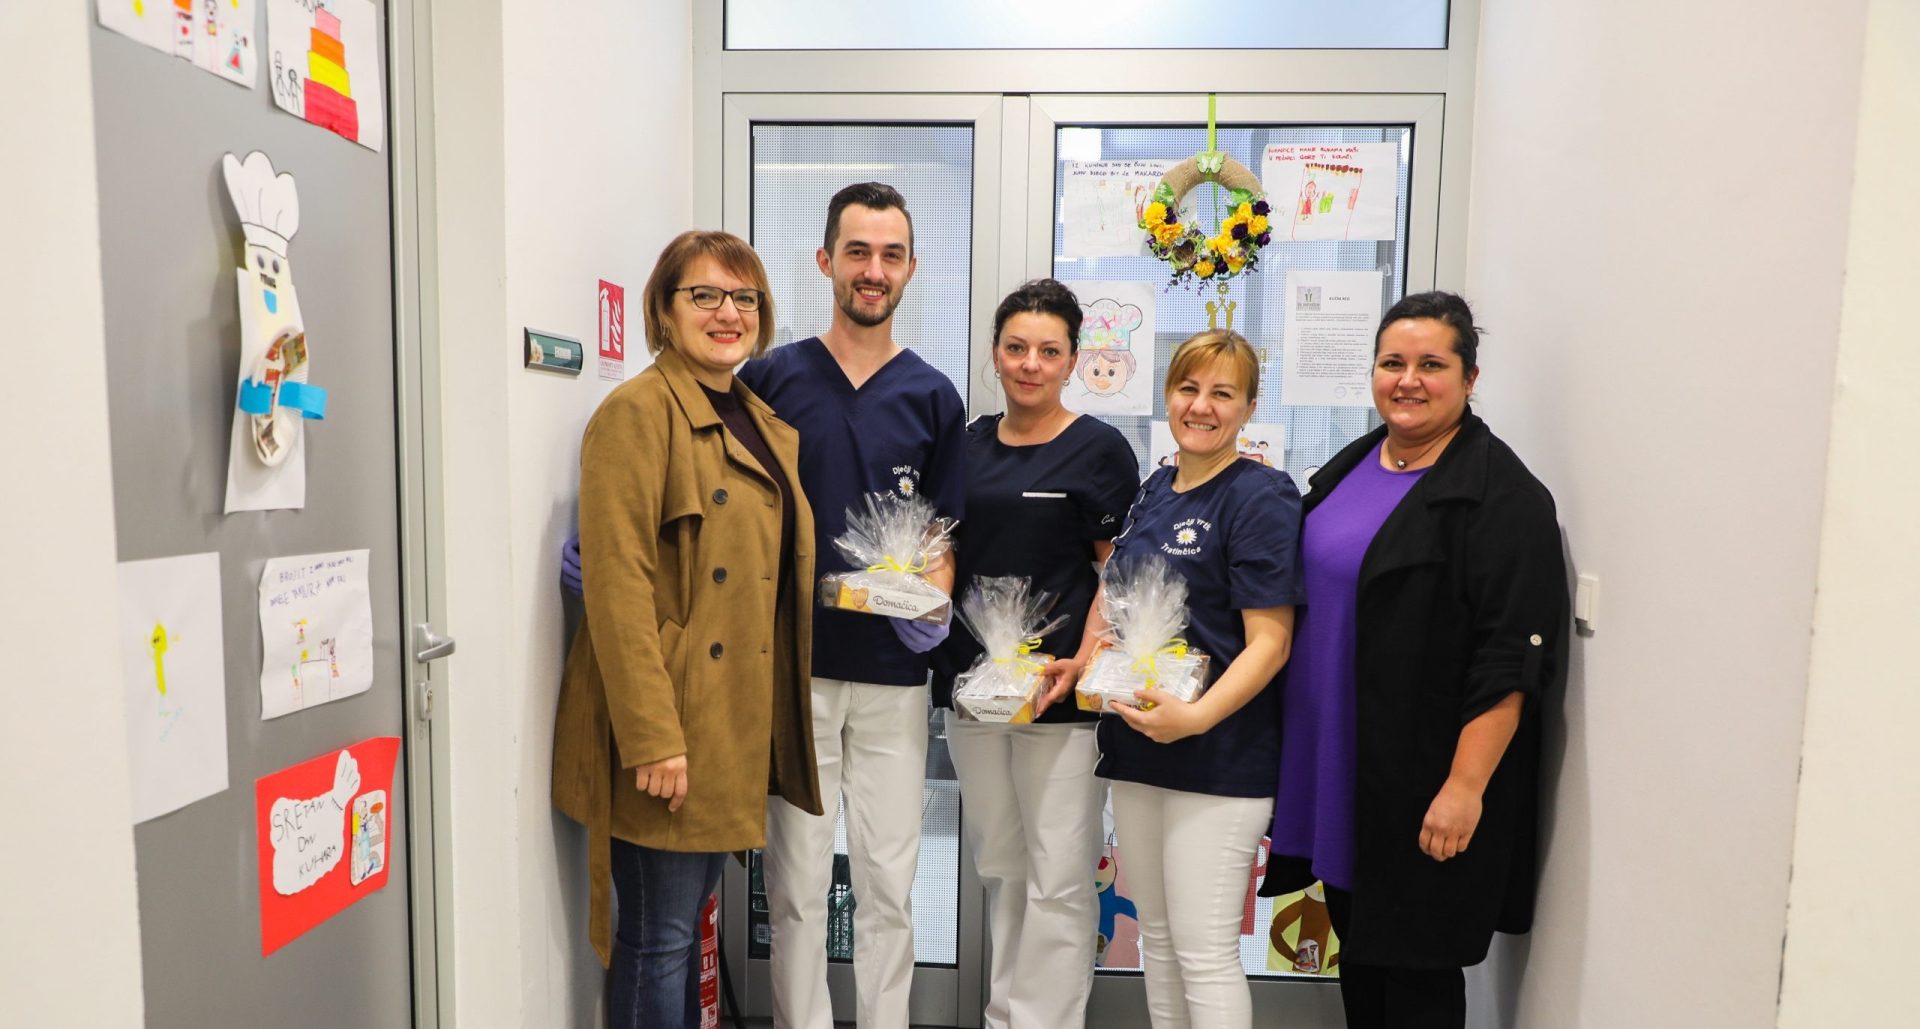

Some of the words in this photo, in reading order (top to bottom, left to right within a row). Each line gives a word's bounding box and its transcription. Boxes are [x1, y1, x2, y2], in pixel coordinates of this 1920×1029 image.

[1160, 542, 1202, 556] Tratinčica
[272, 800, 325, 842] SRETAN
[297, 833, 317, 853] DAN
